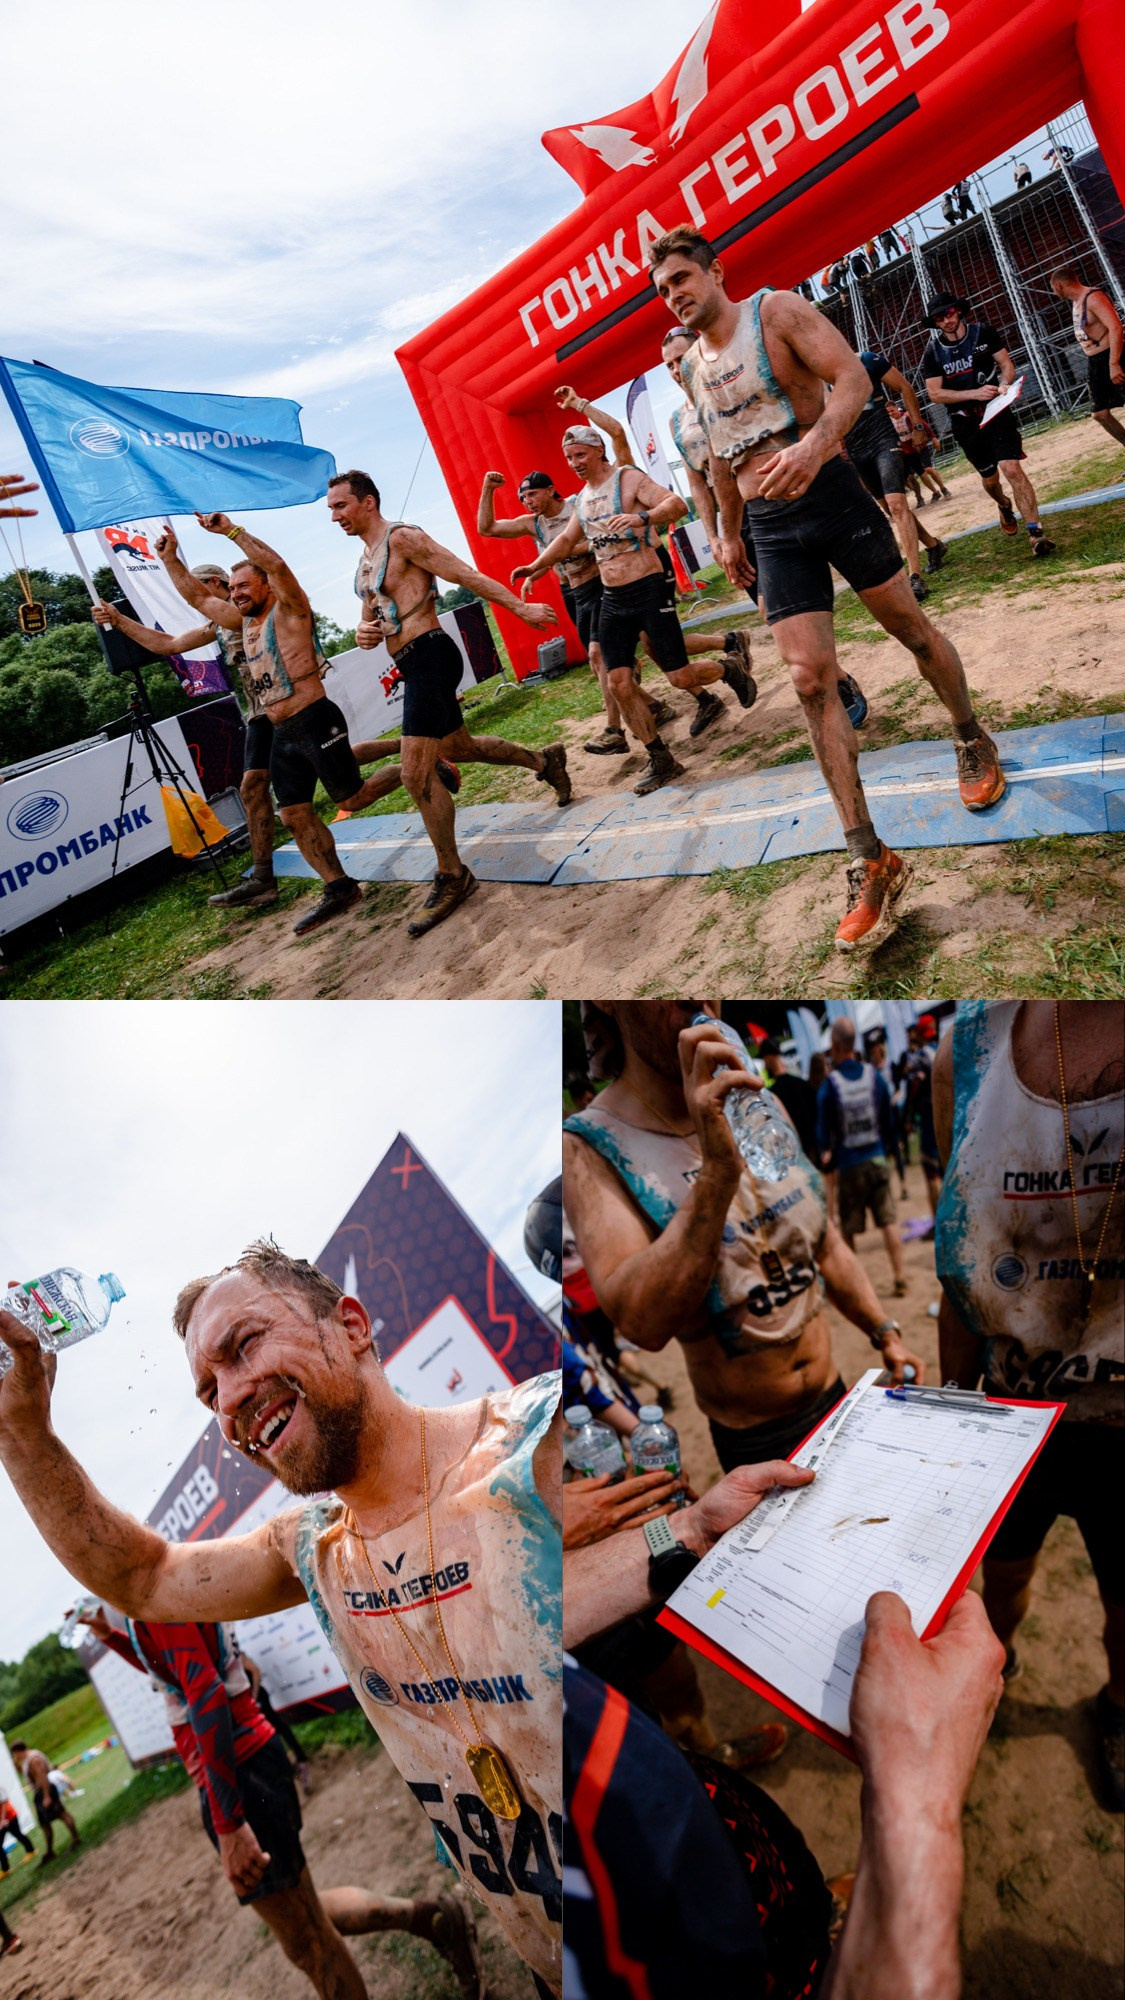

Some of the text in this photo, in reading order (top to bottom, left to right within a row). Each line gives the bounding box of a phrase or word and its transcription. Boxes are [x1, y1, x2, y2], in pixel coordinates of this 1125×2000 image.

[518, 0, 950, 348] ГОНКА ГЕРОЕВ
[0, 804, 153, 898] ПРОМБАНК
[1003, 1170, 1073, 1192] ГОНКА
[39, 1274, 78, 1323] ЕНЕЖСКАЯ
[158, 1465, 219, 1542] ЕРОЕВ
[401, 1561, 469, 1602] ГЕРОЕВ
